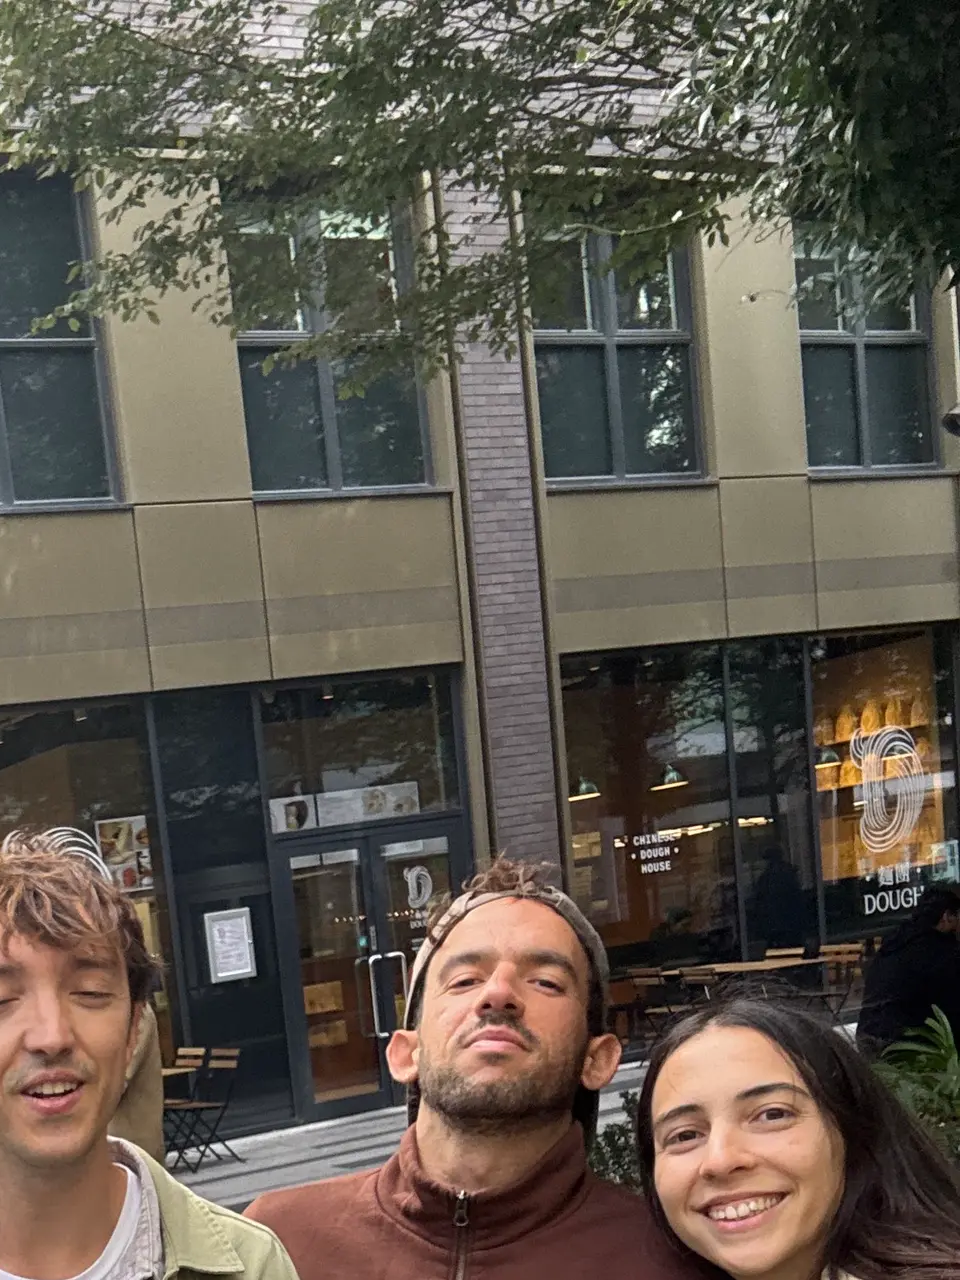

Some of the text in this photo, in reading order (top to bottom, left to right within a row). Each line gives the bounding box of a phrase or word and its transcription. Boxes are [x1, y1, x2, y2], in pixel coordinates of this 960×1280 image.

[633, 833, 676, 846] CHINESE
[640, 846, 671, 860] DOUGH
[641, 860, 672, 874] HOUSE
